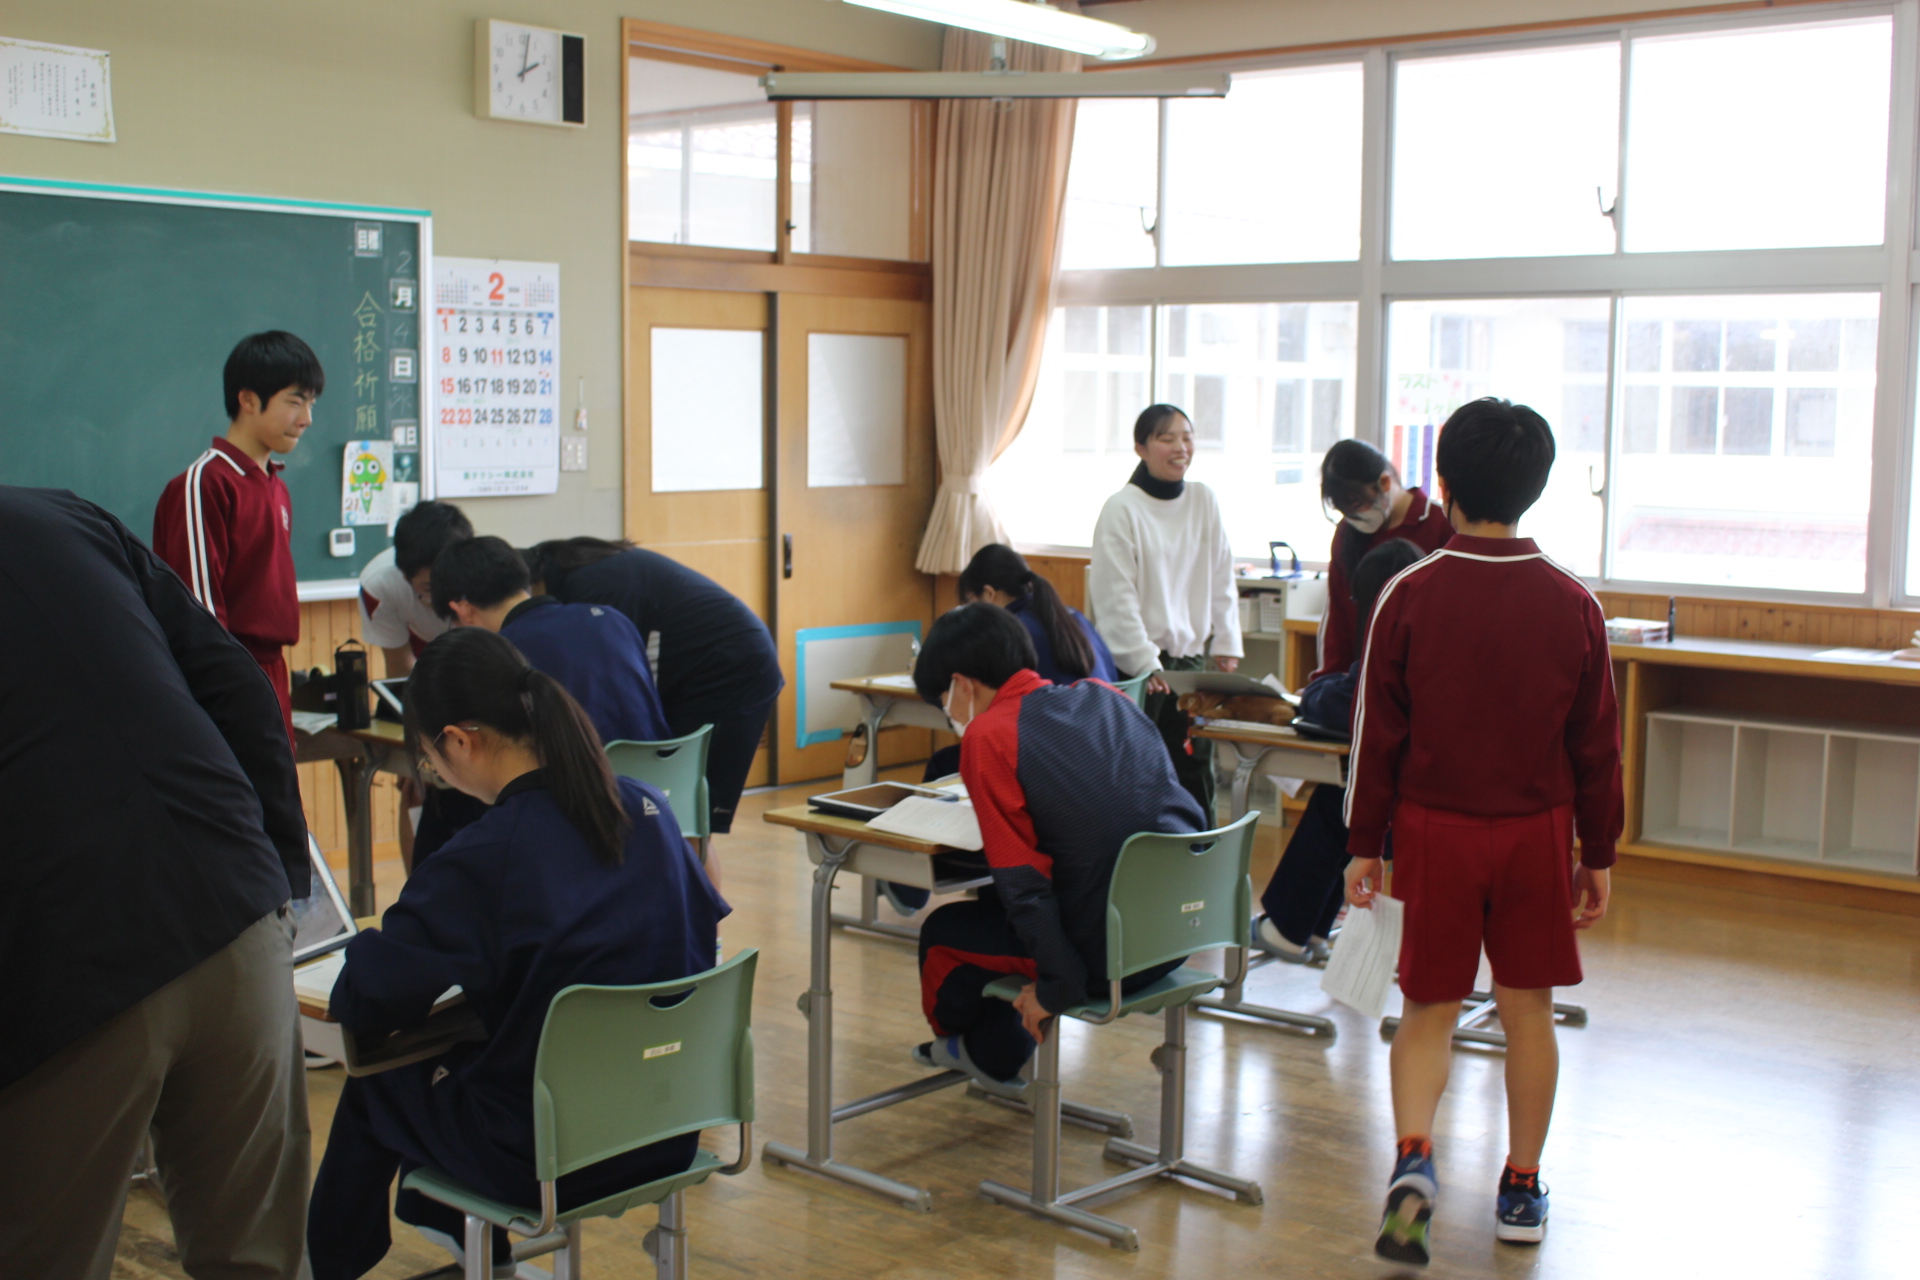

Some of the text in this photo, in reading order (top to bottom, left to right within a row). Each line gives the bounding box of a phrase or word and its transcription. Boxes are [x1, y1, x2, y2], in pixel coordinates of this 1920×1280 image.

[488, 272, 505, 301] 2
[443, 317, 549, 335] 1 2 3 4 5 6 7
[353, 290, 383, 434] 合格祈願
[442, 347, 552, 365] 8 9 10 11 12 13 14
[441, 378, 551, 394] 15 16 17 18 19 20 21
[1398, 374, 1438, 389] ラスト
[441, 409, 552, 424] 22 23 24 25 26 27 28
